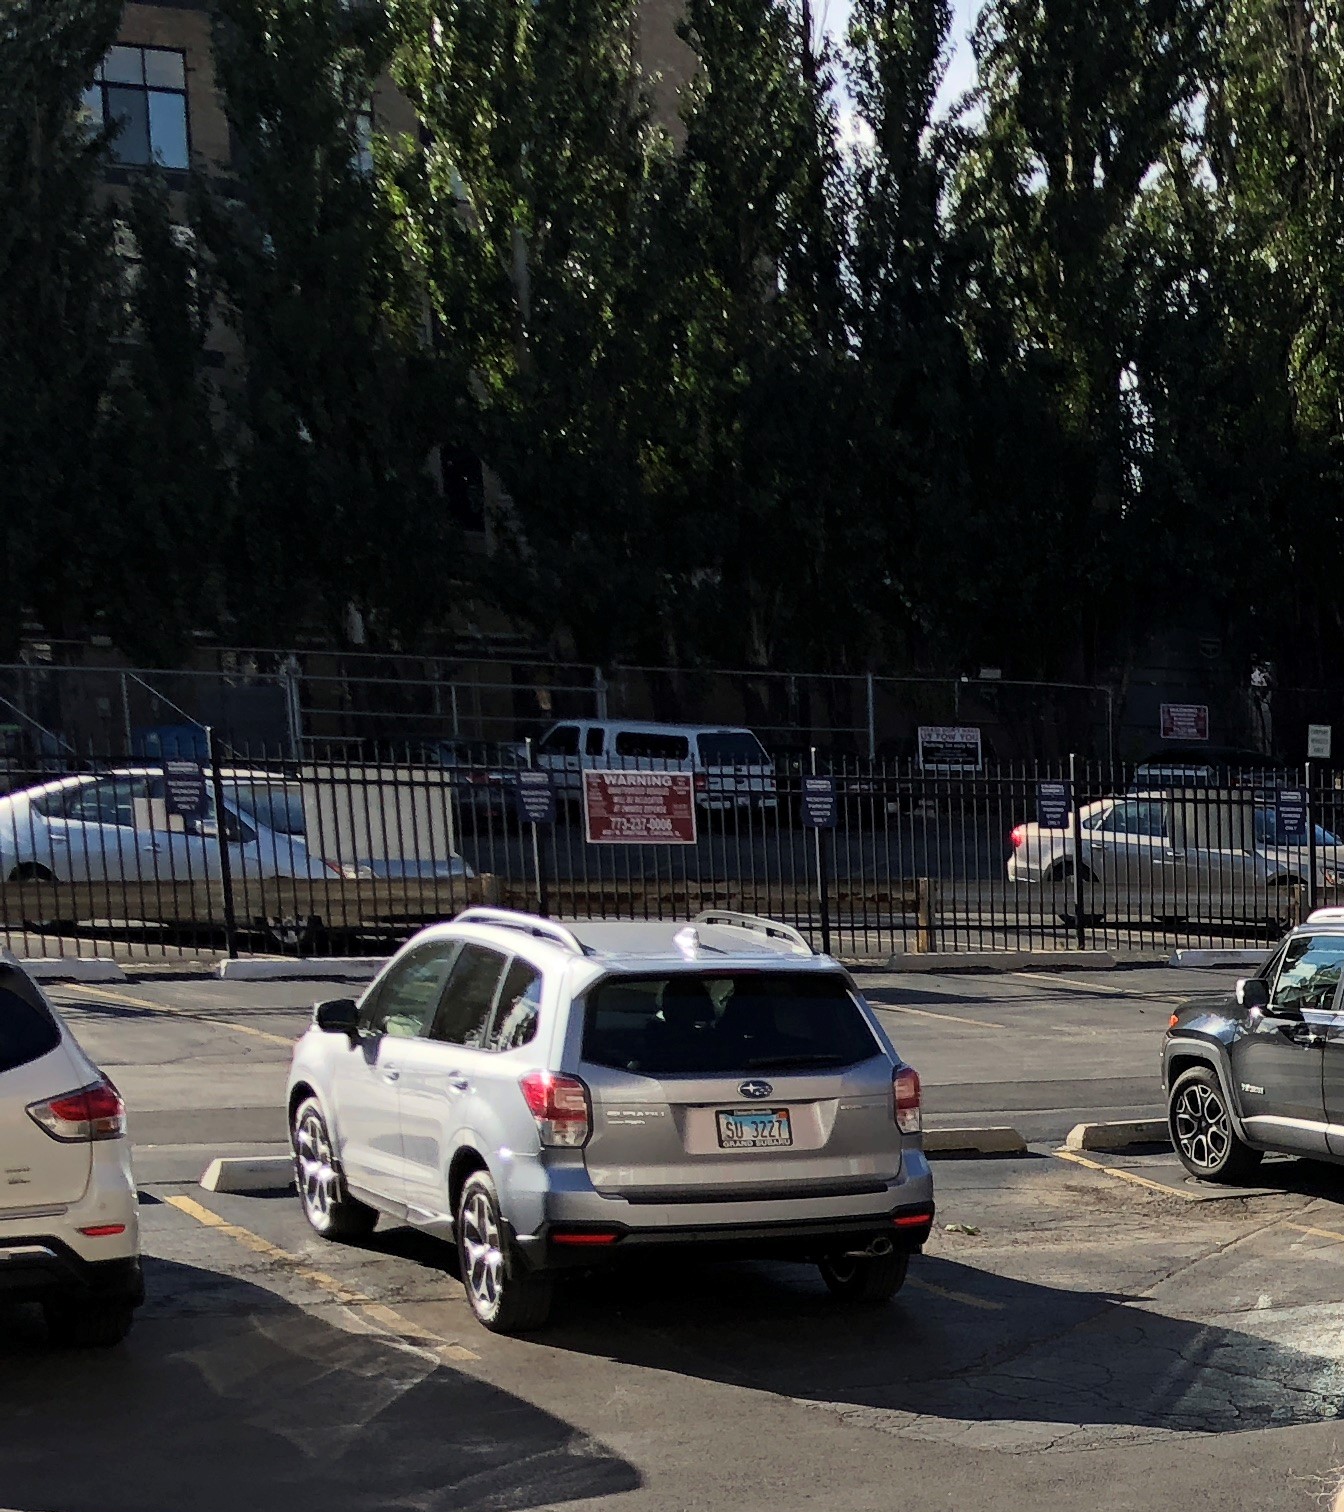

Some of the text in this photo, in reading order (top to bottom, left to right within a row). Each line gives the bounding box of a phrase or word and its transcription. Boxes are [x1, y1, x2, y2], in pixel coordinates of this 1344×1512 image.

[603, 773, 673, 787] WARNING
[725, 1119, 782, 1139] SU 3227
[723, 1138, 792, 1148] GRAND SUBARU
